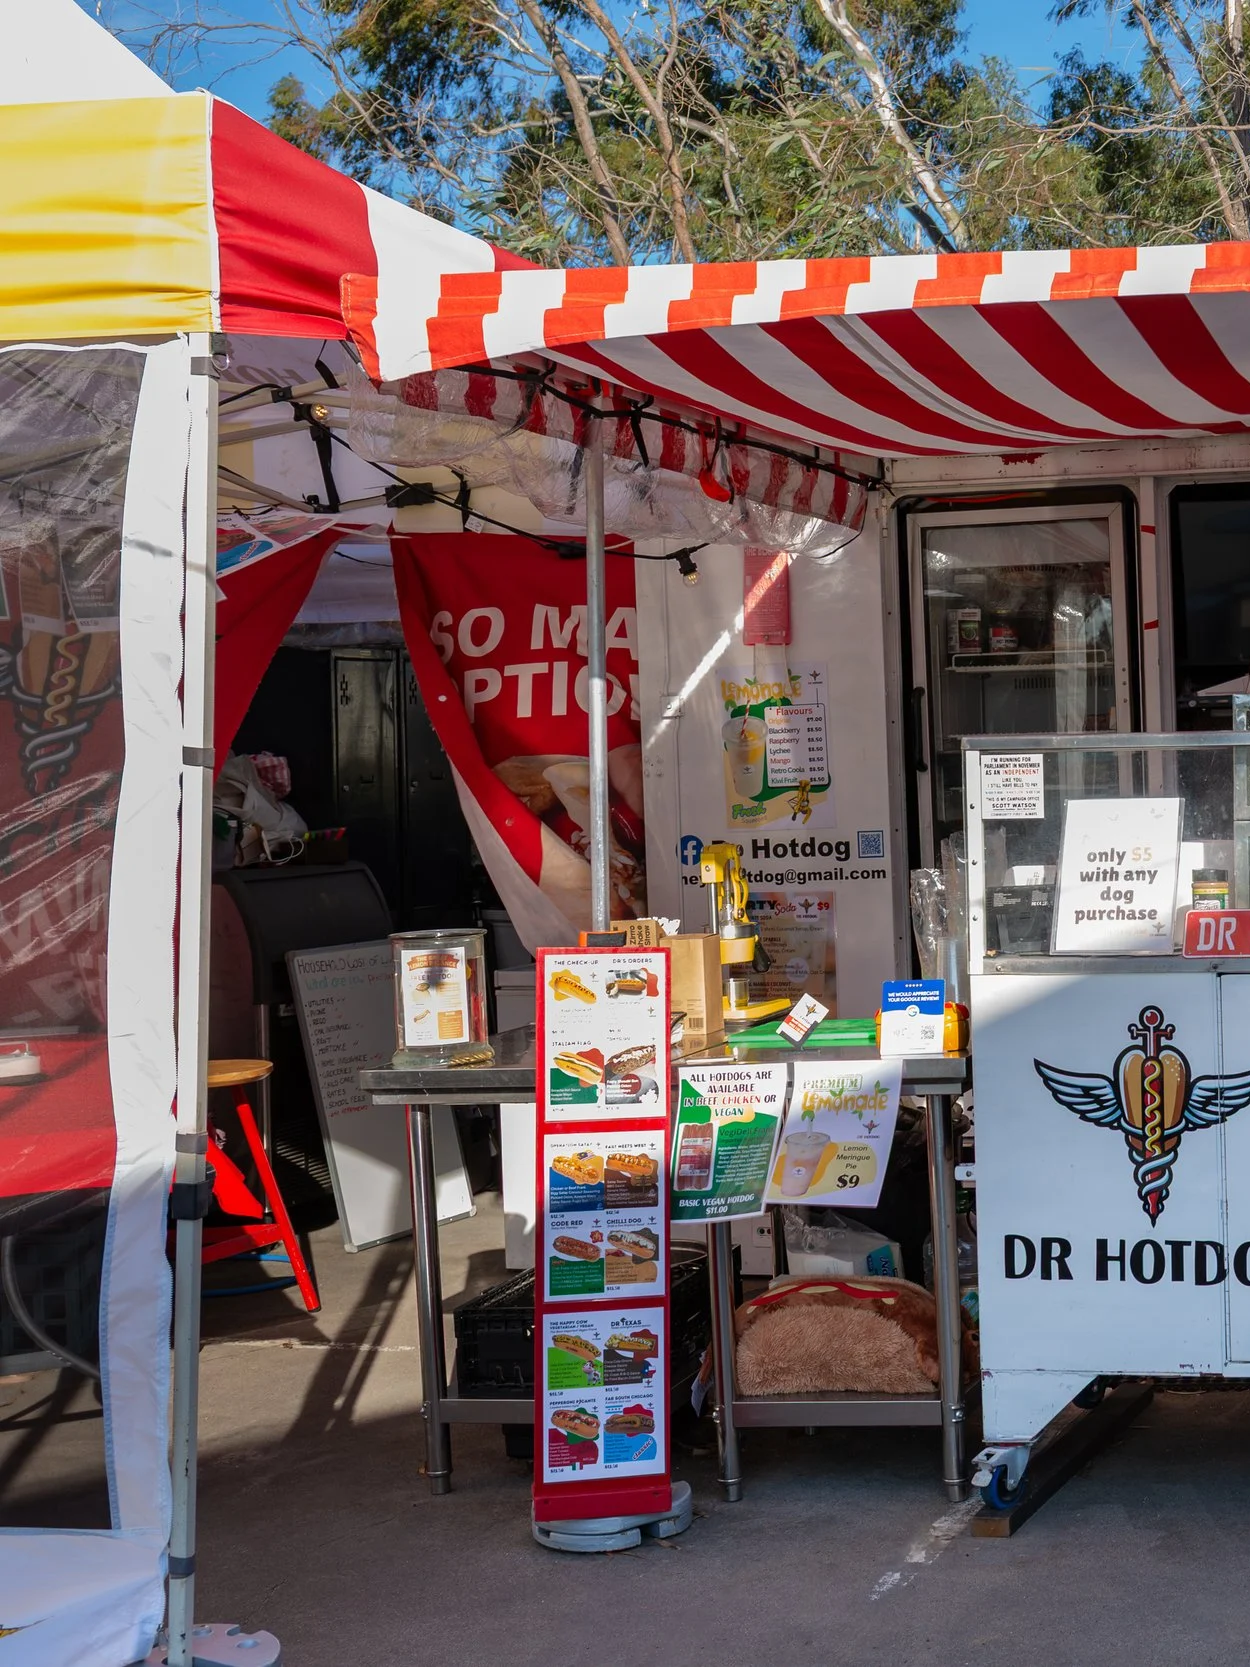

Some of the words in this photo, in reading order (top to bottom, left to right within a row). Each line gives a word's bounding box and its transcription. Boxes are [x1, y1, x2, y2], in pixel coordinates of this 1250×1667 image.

[430, 609, 505, 665] SO
[776, 707, 813, 717] Flavours
[769, 727, 800, 736] Blackberry
[769, 737, 800, 745] Raspberry
[770, 747, 791, 756] Lychee
[770, 757, 791, 765] Mango
[732, 801, 767, 820] Fresh
[751, 836, 850, 862] Hotdog
[1086, 848, 1126, 866] only
[1131, 847, 1153, 861] $5
[1080, 867, 1119, 882] with
[1123, 869, 1158, 885] any
[1100, 886, 1134, 904] dog
[774, 902, 797, 917] Soda
[817, 902, 830, 911] $9
[1074, 906, 1158, 924] purchase
[1196, 916, 1237, 951] DR
[308, 998, 334, 1007] UTILITIES
[313, 1018, 326, 1026] REGO
[690, 1073, 706, 1082] ALL
[709, 1071, 752, 1081] HOTDOGS
[755, 1071, 773, 1080] ARE
[707, 1083, 756, 1094] AVAILABLE
[803, 1078, 859, 1089] PREMIUM
[327, 1089, 346, 1098] RATES
[684, 1098, 694, 1107] IN
[722, 1095, 761, 1105] CHICKEN
[764, 1095, 777, 1103] OR
[801, 1090, 889, 1116] Lemonade
[714, 1108, 744, 1117] VEGAN
[836, 1174, 860, 1189] $9
[679, 1199, 701, 1207] BASIC
[702, 1197, 726, 1206] VEGAN
[727, 1193, 755, 1204] HOTDOG
[705, 1206, 729, 1215] $11.00
[1004, 1234, 1074, 1280] DR
[621, 1319, 642, 1327] TEXAS
